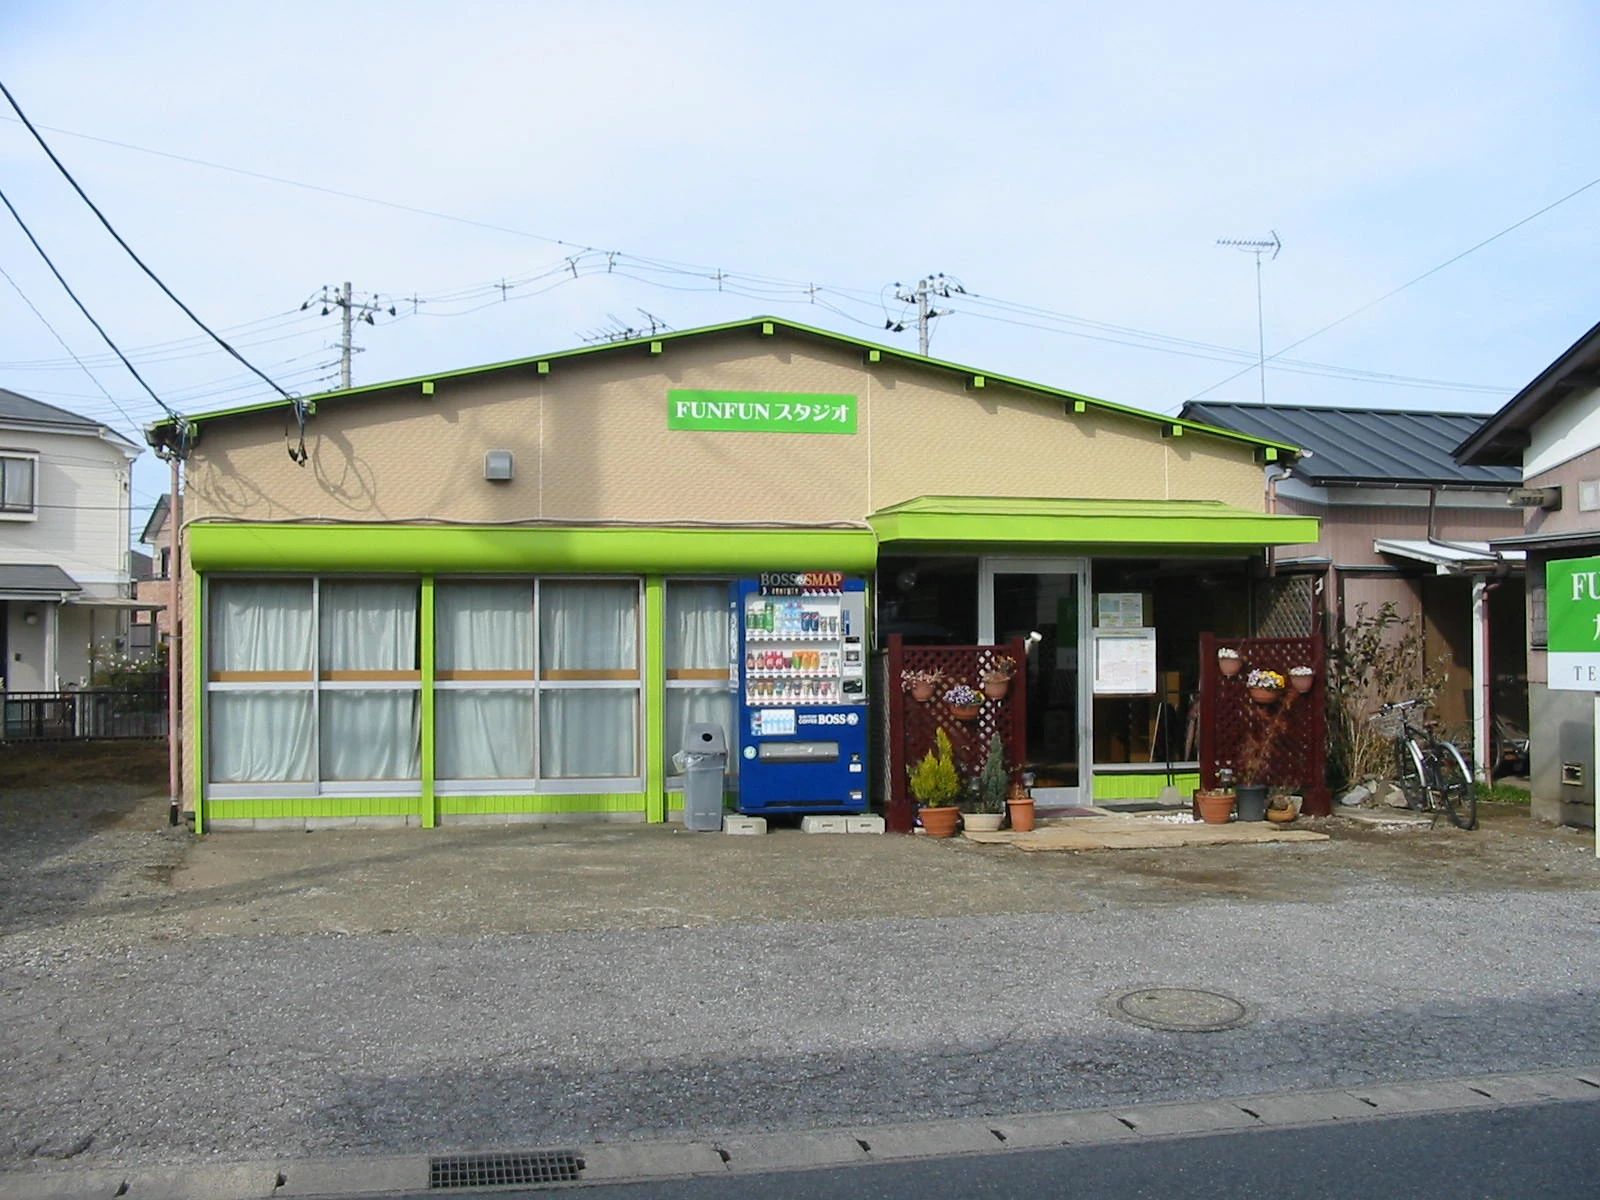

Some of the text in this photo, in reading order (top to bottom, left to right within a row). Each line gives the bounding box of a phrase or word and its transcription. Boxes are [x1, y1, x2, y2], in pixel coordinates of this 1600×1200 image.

[676, 401, 849, 423] FUNFUN スタジオ
[761, 573, 842, 586] BOSS SMAP
[818, 713, 846, 725] BOSS
